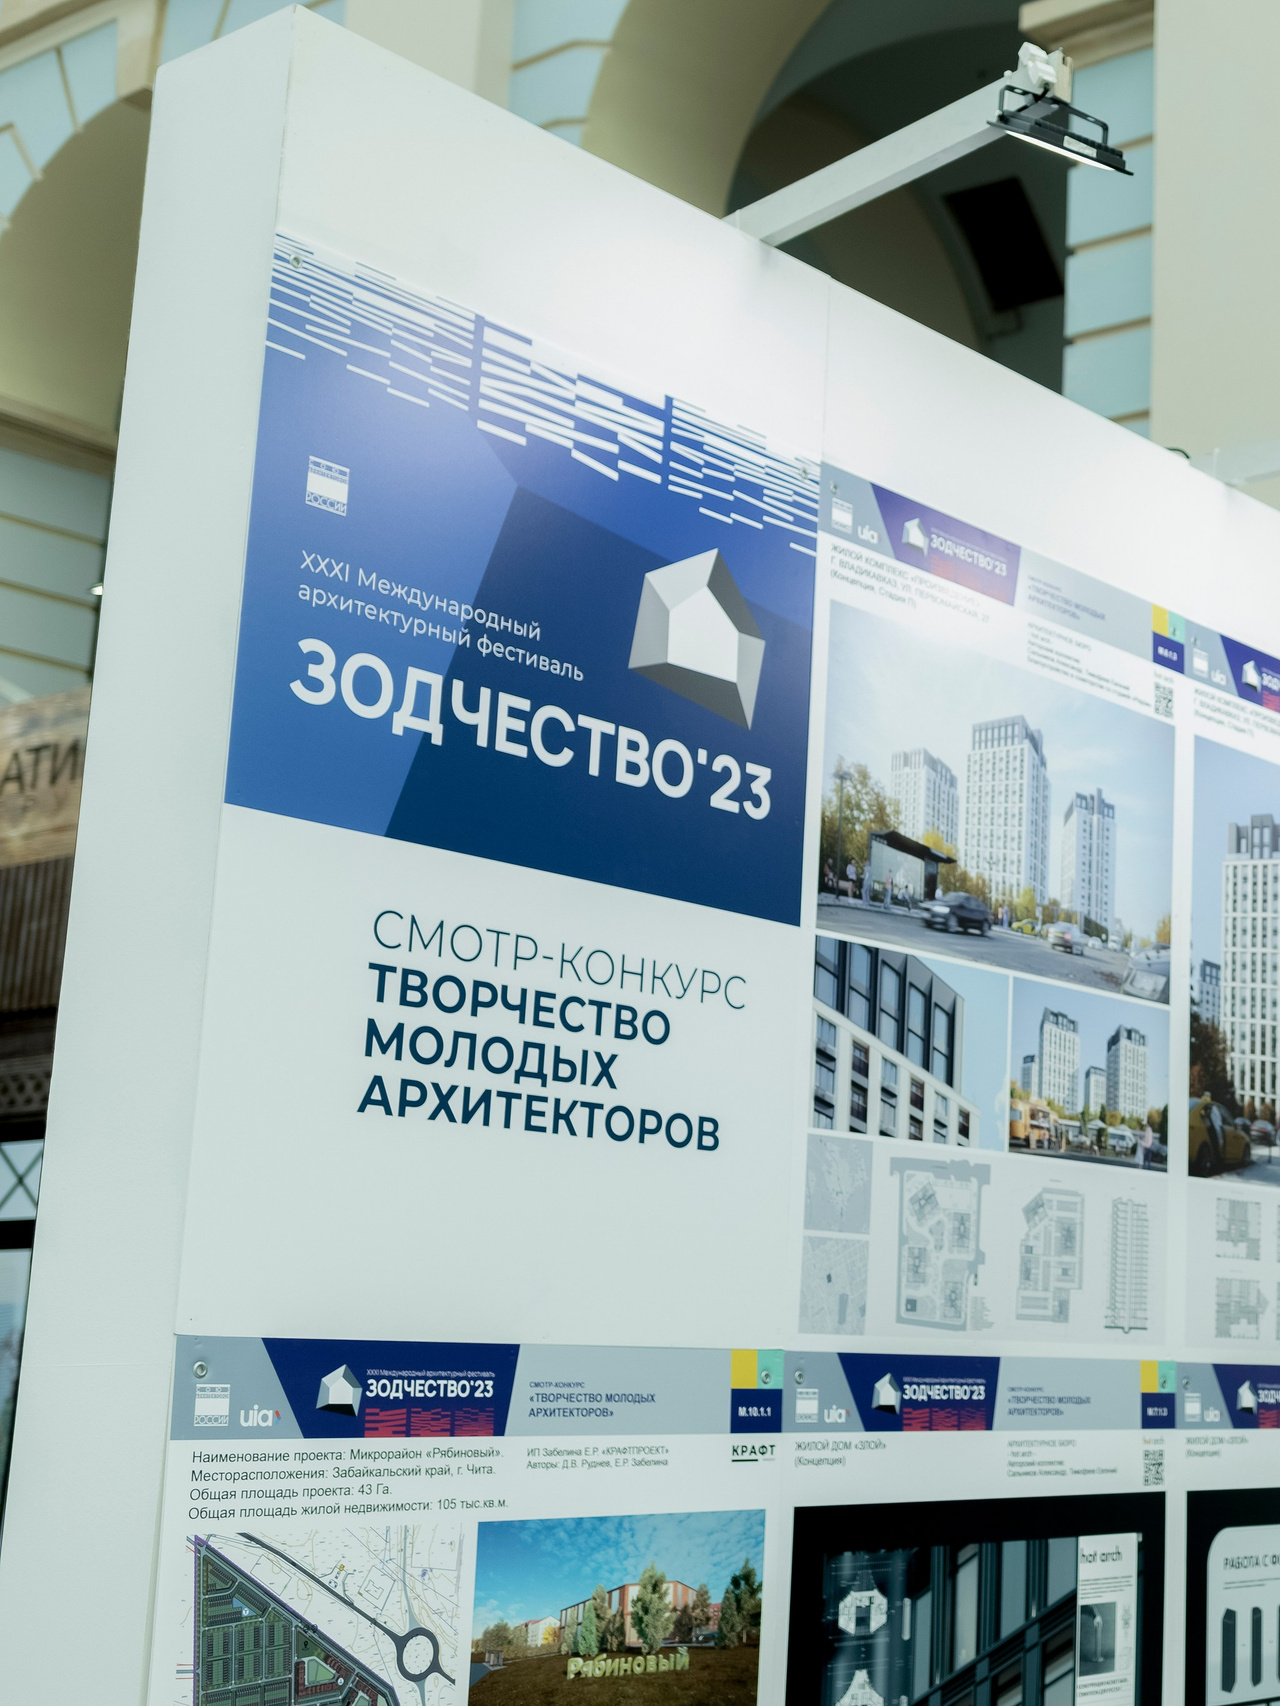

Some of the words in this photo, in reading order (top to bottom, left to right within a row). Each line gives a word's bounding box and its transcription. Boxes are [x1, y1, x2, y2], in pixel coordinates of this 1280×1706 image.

[300, 549, 350, 583] XXXI
[357, 567, 542, 642] Международный
[298, 583, 471, 649] архитектурный
[476, 633, 585, 682] фестиваль
[289, 637, 773, 821] ЗОДЧЕСТВО'23
[372, 909, 748, 1010] СМОТР-КОНКУРС
[367, 961, 671, 1046] ТВОРЧЕСТВО
[363, 1017, 619, 1090] МОЛОДЫХ
[356, 1074, 721, 1152] АРХИТЕКТОРОВ
[365, 1378, 494, 1400] ЗОДЧЕСТВО'23
[529, 1392, 603, 1403] «ТВОРЧЕСТВО
[604, 1392, 656, 1405] МОЛОДЫХ
[902, 1384, 986, 1402] ЗОДЧЕСТВО'23
[240, 1404, 273, 1428] uia
[528, 1407, 614, 1418] АРХИТЕКТОРОВ»
[824, 1405, 847, 1424] uia
[192, 1450, 290, 1464] Наименование
[293, 1451, 346, 1464] проекта:
[349, 1448, 422, 1462] Микрорайон
[425, 1446, 504, 1459] «Рябиновый».
[732, 1444, 776, 1456] КРАФТ
[190, 1469, 328, 1484] Месторасположения:
[332, 1465, 422, 1479] Забайкальский
[425, 1465, 453, 1479] край,
[466, 1463, 496, 1475] Чита.
[189, 1488, 237, 1502] Общая
[240, 1488, 299, 1500] площадь
[302, 1486, 354, 1500] проекта:
[357, 1483, 373, 1496] 43
[376, 1483, 392, 1496] Га.
[188, 1506, 236, 1520] Общая
[239, 1505, 298, 1519] площадь
[300, 1502, 341, 1516] жилой
[344, 1500, 433, 1515] недвижимости:
[437, 1498, 457, 1510] 105
[567, 1646, 690, 1681] Рябиновый
